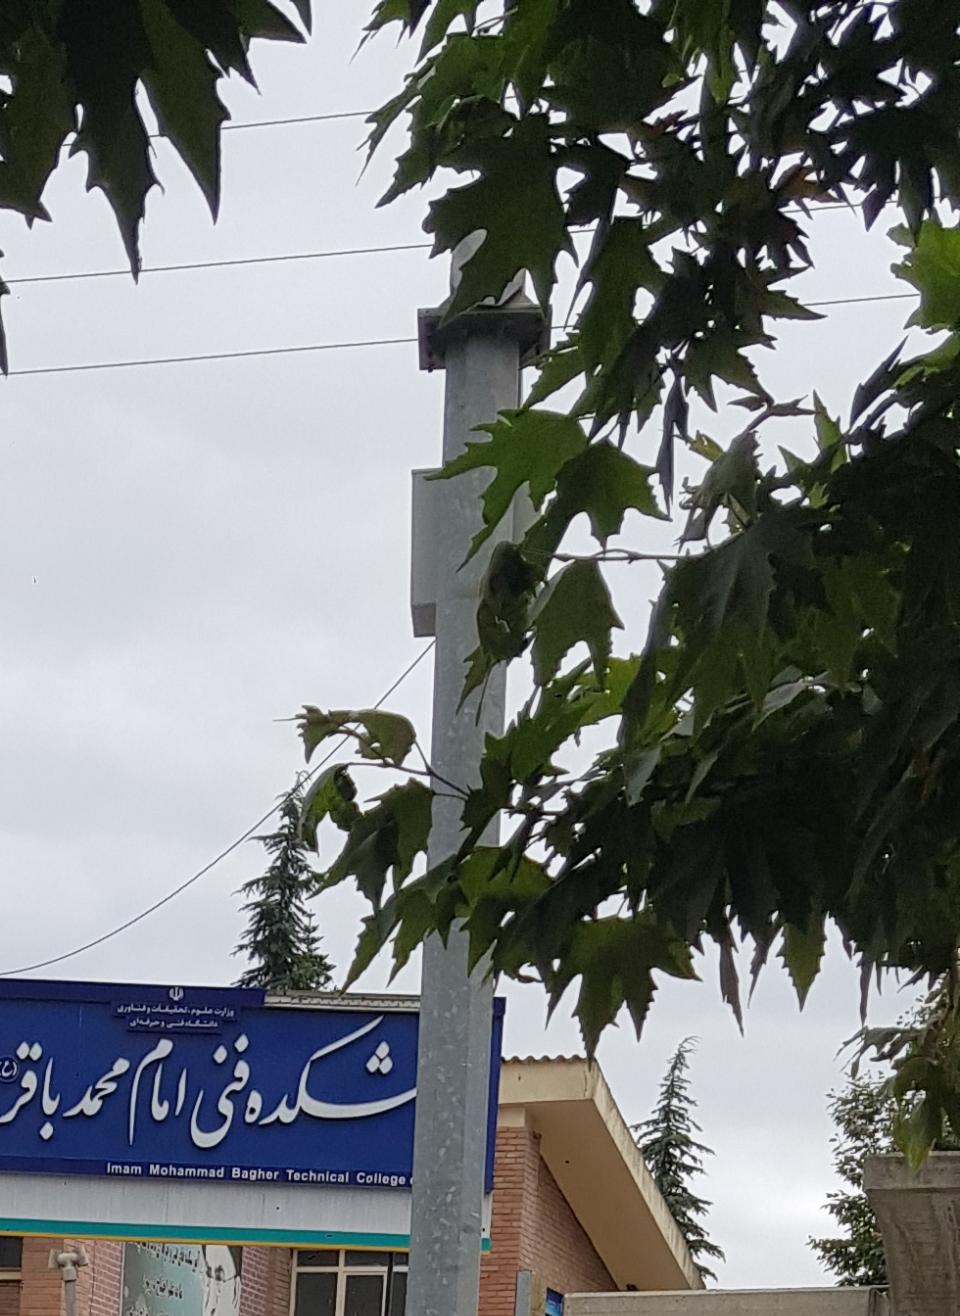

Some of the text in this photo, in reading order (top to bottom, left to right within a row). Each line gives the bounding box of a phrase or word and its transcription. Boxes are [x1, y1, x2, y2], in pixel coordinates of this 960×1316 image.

[61, 1056, 131, 1118] محمد
[129, 1039, 187, 1146] امام
[191, 1034, 250, 1148] فنی
[107, 1162, 141, 1175] Imam
[149, 1164, 225, 1178] Mohammad
[231, 1167, 280, 1182] Bagher
[286, 1169, 350, 1184] Technical
[356, 1172, 407, 1187] College
